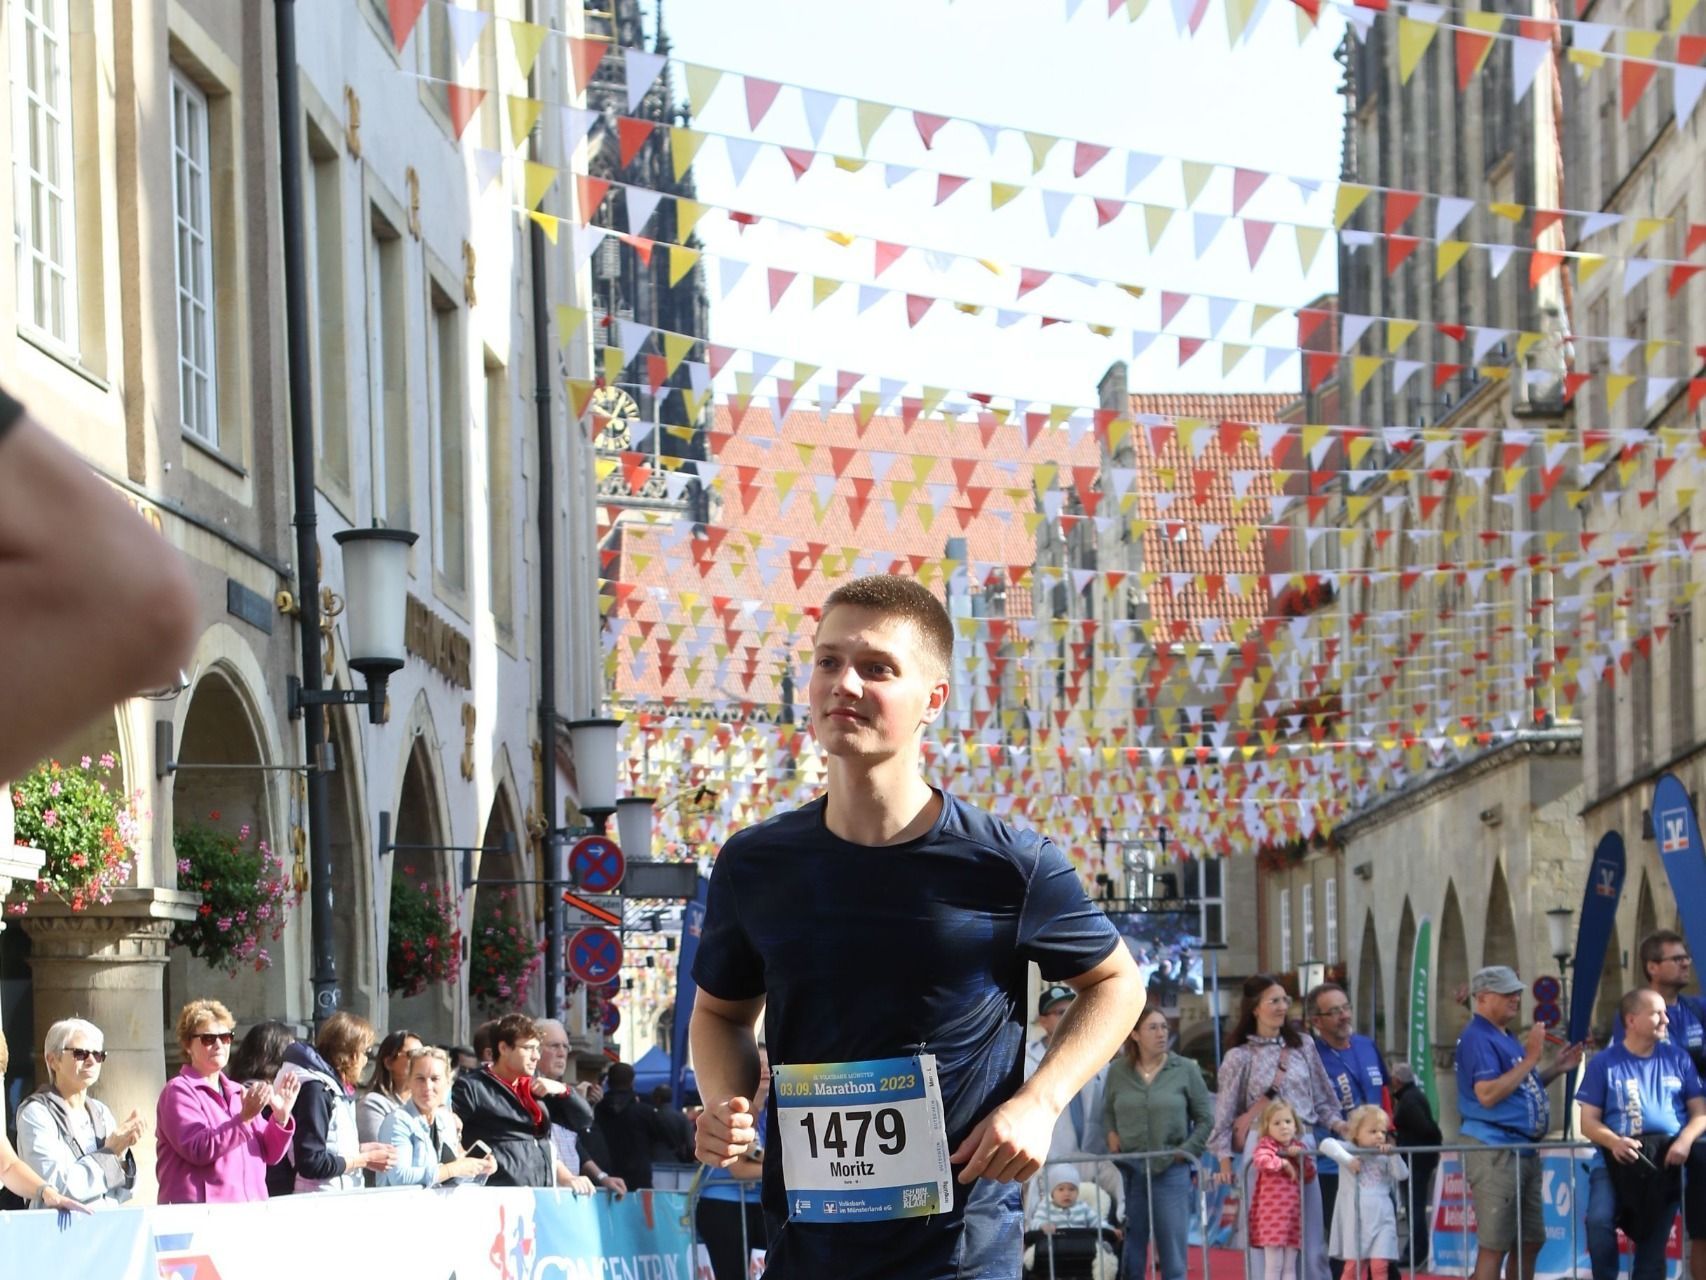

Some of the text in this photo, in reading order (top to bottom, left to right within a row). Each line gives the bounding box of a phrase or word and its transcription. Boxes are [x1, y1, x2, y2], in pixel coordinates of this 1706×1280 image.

[780, 1074, 916, 1096] 03.09. Marathon 2023
[800, 1108, 906, 1159] 1479
[830, 1161, 875, 1178] Moritz
[847, 1205, 882, 1213] Münsterland
